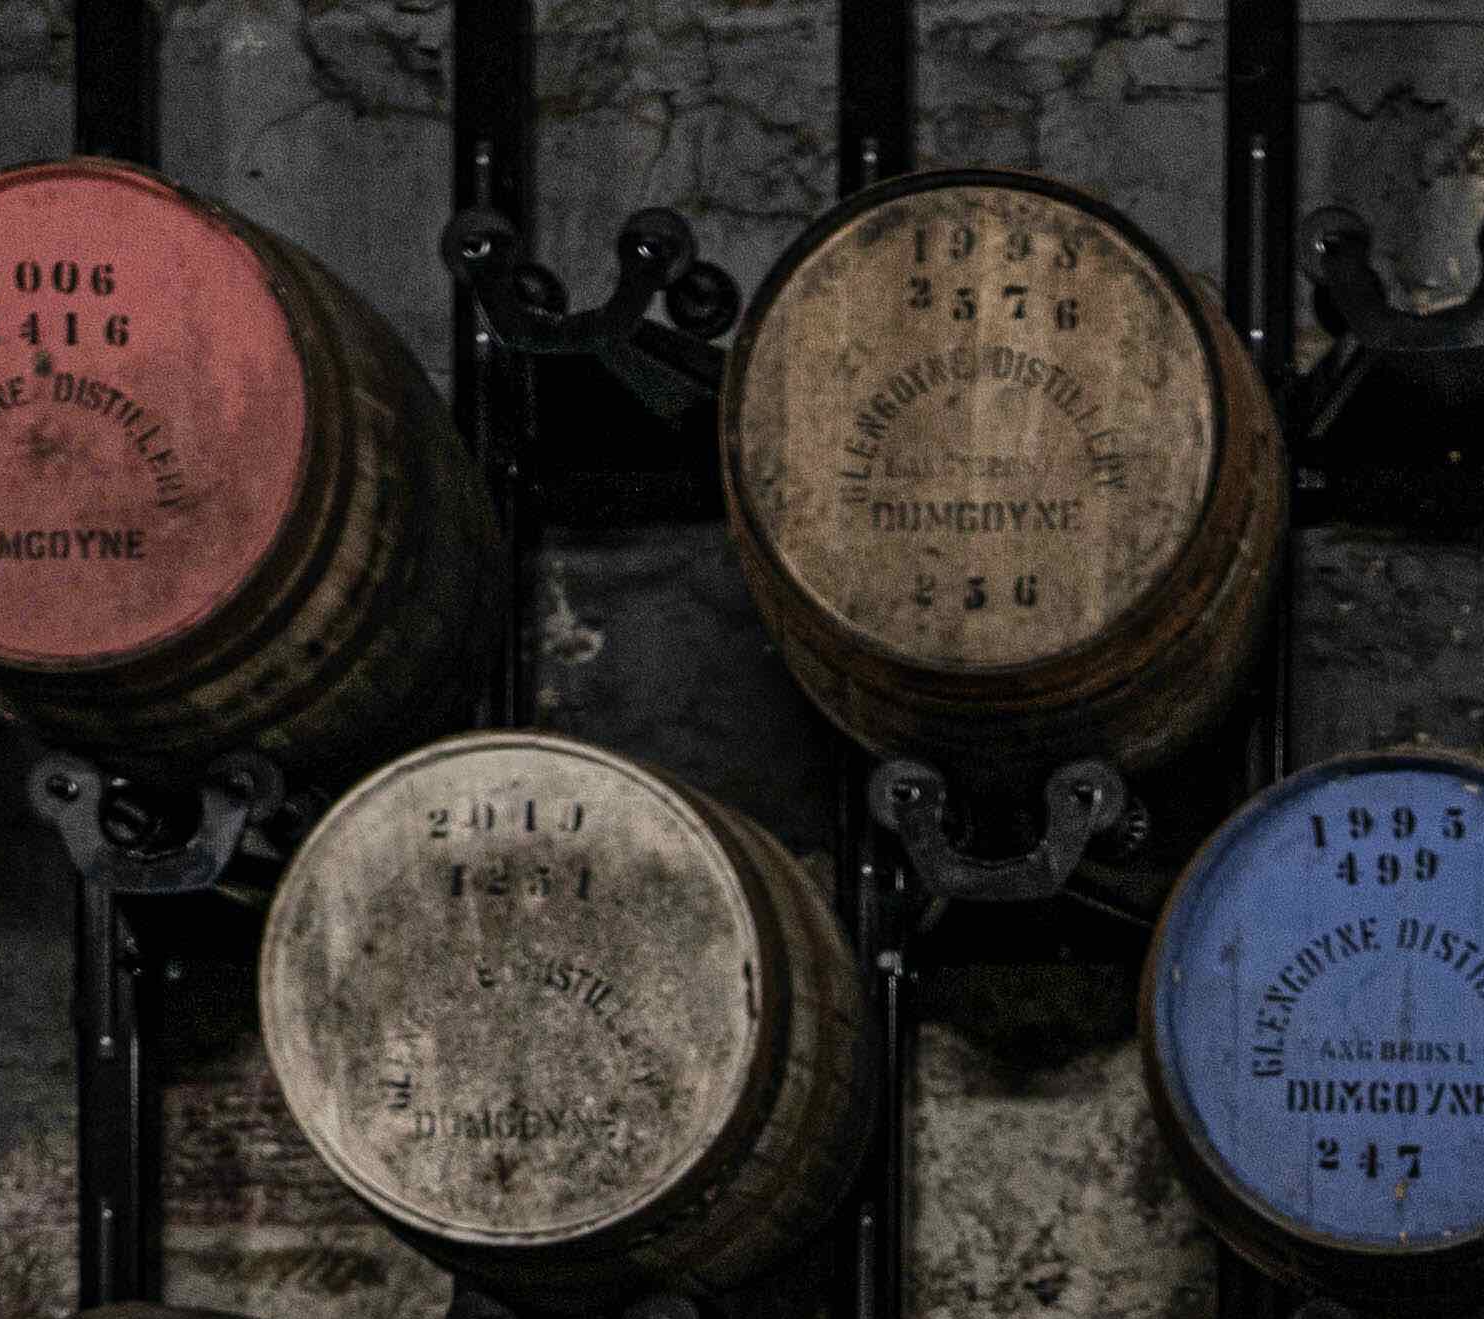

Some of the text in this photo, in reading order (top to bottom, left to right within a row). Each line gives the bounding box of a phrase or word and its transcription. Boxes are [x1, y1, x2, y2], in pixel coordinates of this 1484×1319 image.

[52, 372, 189, 509] DISTILLERY
[1310, 807, 1466, 850] 1995
[1335, 846, 1440, 887] 499
[1252, 917, 1381, 1079] GLENGOYNE
[1316, 1138, 1424, 1179] 247
